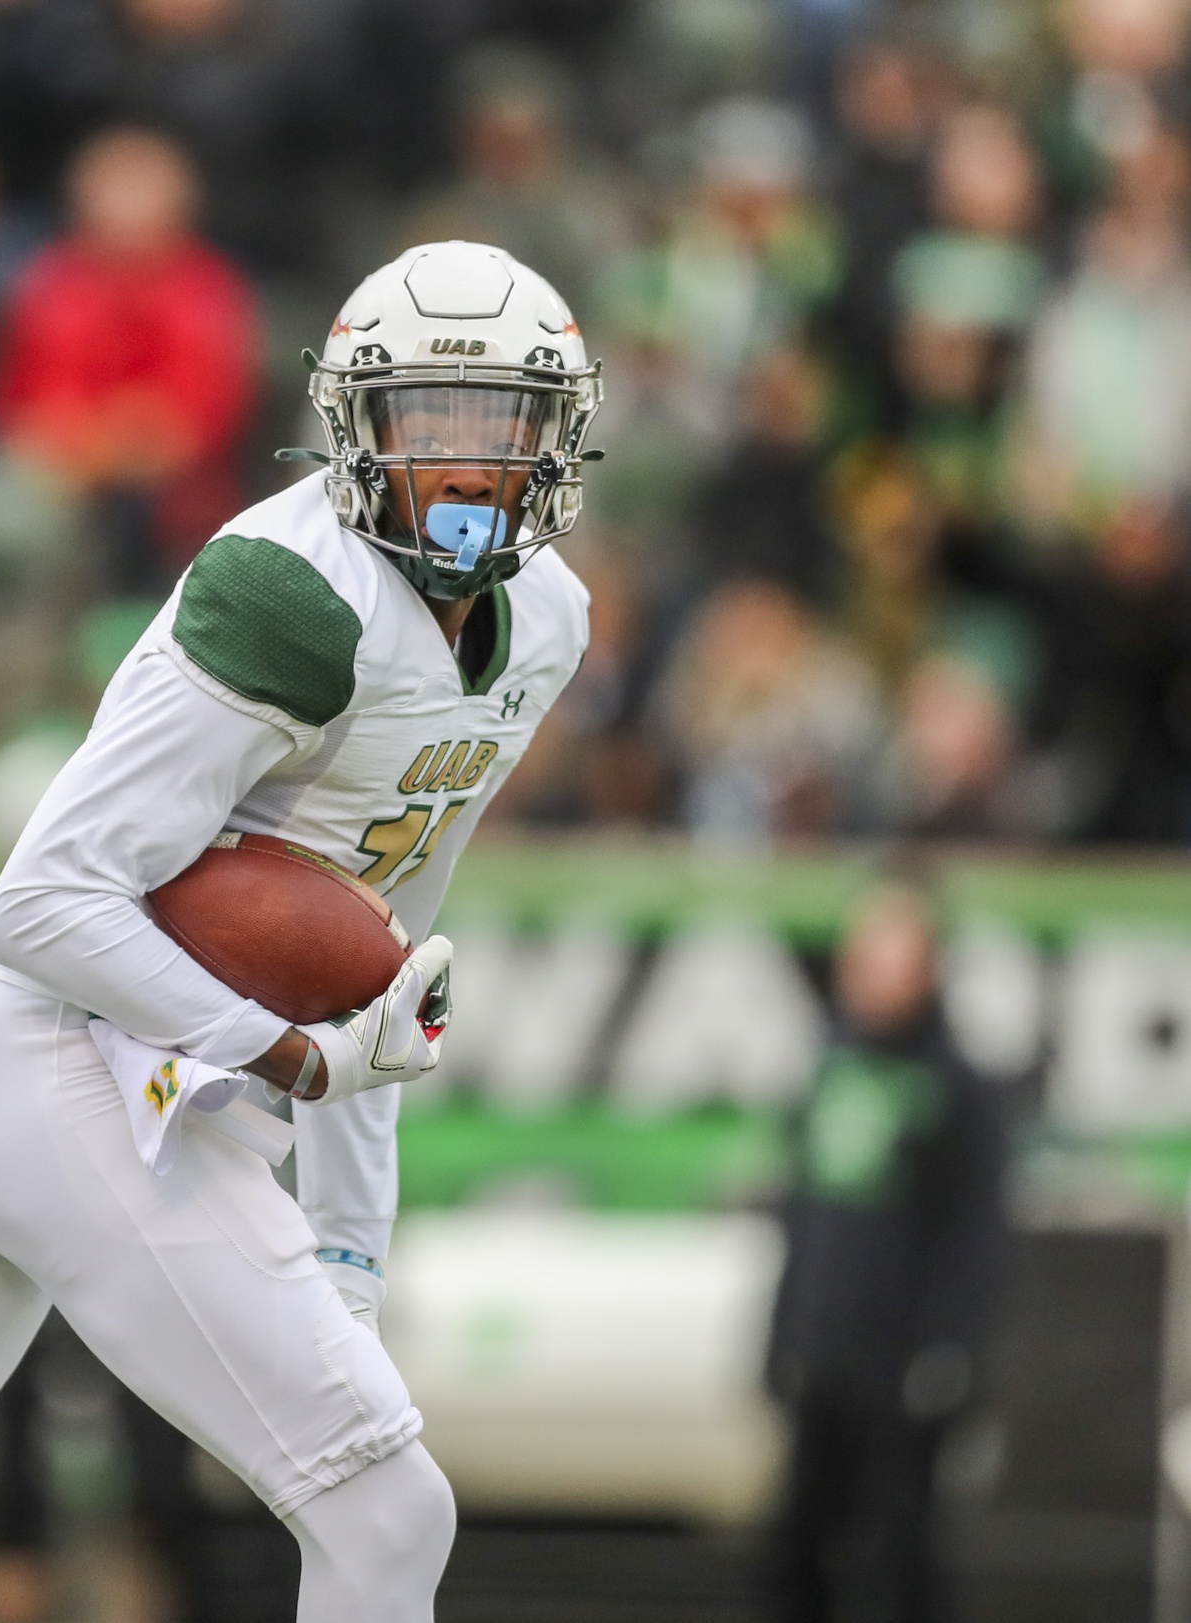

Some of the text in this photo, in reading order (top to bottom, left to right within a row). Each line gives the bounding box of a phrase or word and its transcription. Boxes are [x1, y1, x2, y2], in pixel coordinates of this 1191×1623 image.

[430, 338, 486, 356] UAB
[432, 558, 457, 571] Ridd
[397, 740, 499, 795] UAB
